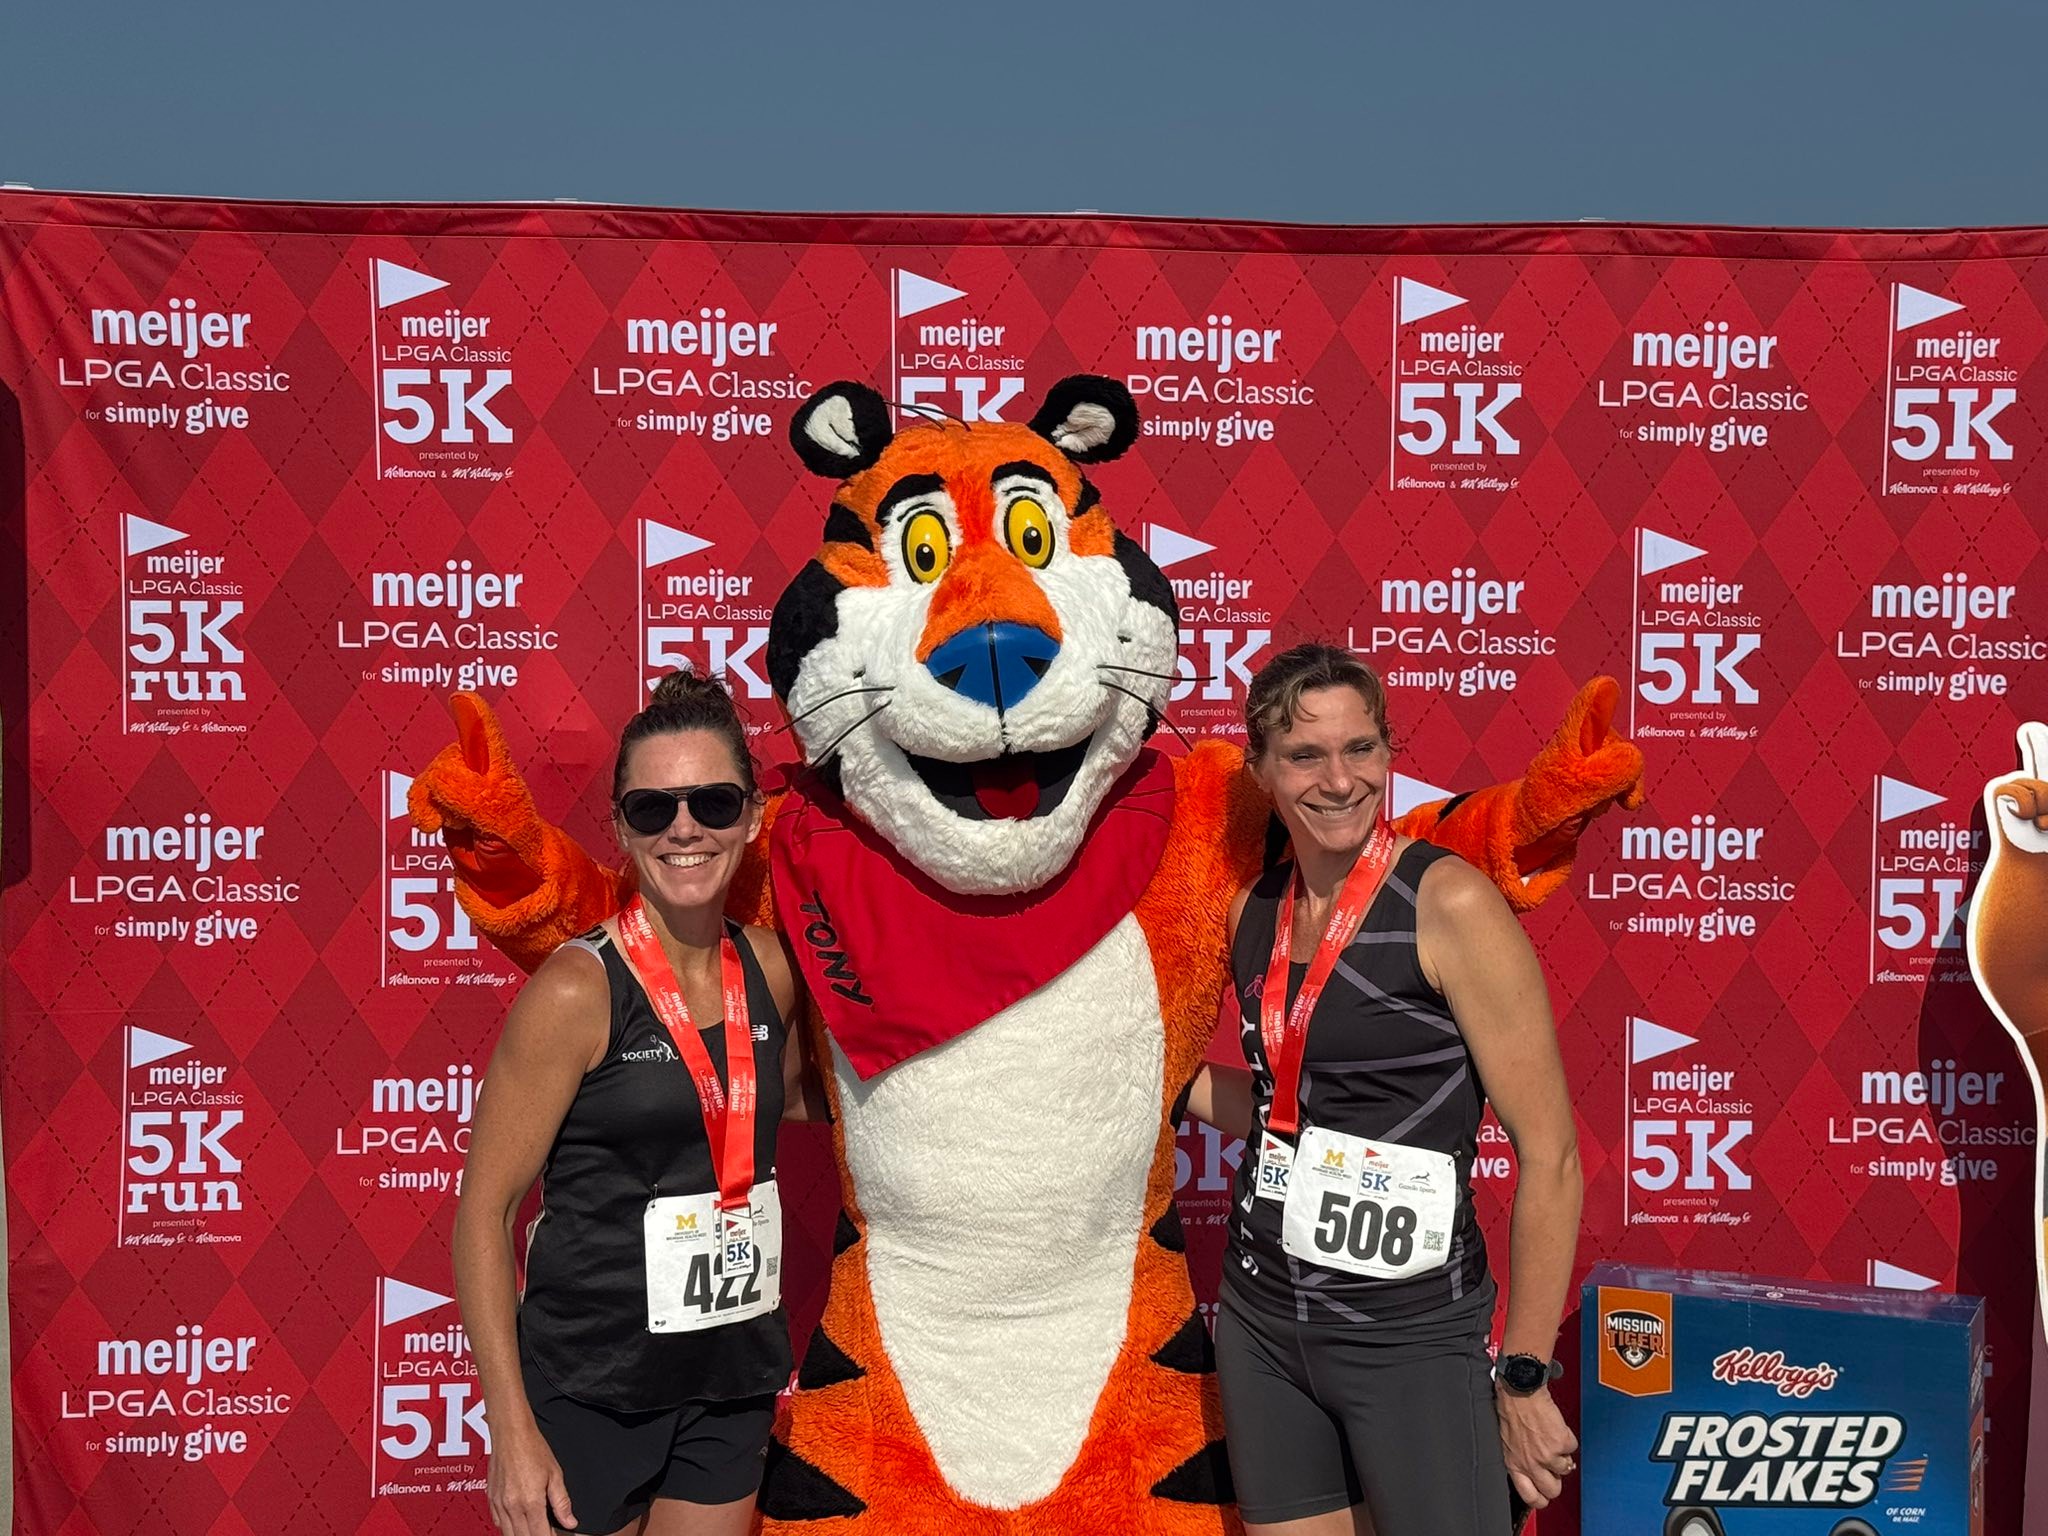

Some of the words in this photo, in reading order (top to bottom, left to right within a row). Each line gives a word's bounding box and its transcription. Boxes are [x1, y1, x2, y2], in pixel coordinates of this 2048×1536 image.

[91, 298, 251, 358] meijer
[402, 309, 490, 344] meijer
[627, 307, 777, 367] meijer
[920, 318, 1005, 352] meijer
[1421, 325, 1504, 359] meijer
[382, 345, 448, 361] LPGA
[450, 346, 511, 362] Classic
[1137, 315, 1281, 373] meijer
[1633, 321, 1777, 379] meijer
[1916, 331, 2000, 364] meijer
[59, 358, 175, 388] LPGA
[181, 363, 290, 391] Classic
[901, 353, 963, 369] LPGA
[966, 354, 1024, 370] Classic
[1401, 360, 1462, 375] LPGA
[1464, 360, 1522, 376] Classic
[1896, 365, 1957, 381] LPGA
[1960, 366, 2017, 382] Classic
[594, 367, 703, 396] LPGA
[709, 371, 812, 399] Classic
[900, 376, 1025, 423] 5K
[1214, 377, 1314, 405] Classic
[1599, 380, 1703, 408] LPGA
[1709, 383, 1808, 411] Classic
[85, 409, 100, 420] for
[105, 401, 180, 428] simply
[185, 397, 249, 434] give
[383, 369, 513, 444] 5K
[617, 417, 632, 427] for
[637, 409, 707, 436] simply
[712, 405, 772, 441] give
[1398, 383, 1522, 455] 5K
[1143, 415, 1211, 441] simply
[1216, 411, 1274, 447] give
[1620, 429, 1634, 439] for
[1638, 421, 1706, 447] simply
[1709, 417, 1768, 452] give
[1891, 388, 2016, 461] 5K
[419, 451, 466, 460] presented
[468, 451, 479, 462] by
[147, 550, 225, 579] meijer
[130, 580, 187, 594] LPGA
[189, 581, 243, 595] Classic
[373, 560, 523, 619] meijer
[667, 568, 753, 602] meijer
[1170, 572, 1252, 605] meijer
[1382, 567, 1524, 625] meijer
[1661, 576, 1743, 610] meijer
[1872, 572, 2015, 629] meijer
[648, 603, 710, 619] LPGA
[713, 604, 772, 620] Classic
[1213, 607, 1271, 623] Classic
[1641, 610, 1701, 626] LPGA
[1704, 611, 1761, 627] Classic
[129, 600, 244, 664] 5K
[338, 621, 449, 648] LPGA
[455, 623, 558, 650] Classic
[1348, 627, 1452, 653] LPGA
[1457, 629, 1556, 655] Classic
[1838, 631, 1942, 658] LPGA
[1948, 633, 2047, 660] Classic
[362, 670, 377, 680] for
[382, 662, 453, 687] simply
[457, 657, 518, 691] give
[647, 627, 772, 698] 5K
[1387, 666, 1455, 691] simply
[1459, 661, 1517, 697] give
[1638, 633, 1761, 704] 5K
[131, 671, 246, 701] run
[1858, 679, 1873, 689] for
[1877, 671, 1945, 696] simply
[1948, 666, 2007, 701] give
[107, 813, 264, 872] meijer
[1622, 815, 1763, 871] meijer
[1900, 823, 1983, 855] meijer
[391, 855, 454, 870] LPGA
[1881, 856, 1941, 872] LPGA
[70, 875, 187, 903] LPGA
[192, 876, 300, 902] Classic
[1589, 873, 1692, 899] LPGA
[1697, 875, 1795, 901] Classic
[94, 925, 110, 935] for
[115, 916, 190, 941] simply
[194, 910, 257, 946] give
[1609, 920, 1624, 930] for
[1627, 912, 1694, 937] simply
[1698, 907, 1756, 942] give
[799, 889, 873, 1007] TONY
[622, 1050, 661, 1061] SOCIETY
[150, 1060, 227, 1090] meijer
[1653, 1064, 1734, 1097] meijer
[1861, 1060, 2004, 1116] meijer
[131, 1091, 188, 1106] LPGA
[190, 1091, 244, 1105] Classic
[1633, 1098, 1693, 1113] LPGA
[1696, 1098, 1753, 1114] Classic
[128, 1110, 243, 1176] 5K
[337, 1127, 448, 1154] LPGA
[1829, 1117, 1933, 1143] LPGA
[1937, 1120, 2036, 1146] Classic
[1323, 1149, 1346, 1168] M
[1631, 1120, 1753, 1191] 5K
[1850, 1164, 1864, 1174] for
[1868, 1156, 1936, 1181] simply
[1940, 1152, 1998, 1187] give
[359, 1176, 374, 1187] for
[379, 1167, 451, 1192] simply
[1263, 1166, 1289, 1187] 5K
[1361, 1172, 1392, 1192] 5K
[127, 1181, 242, 1213] run
[676, 1213, 698, 1230] M
[1314, 1190, 1417, 1266] 508
[727, 1241, 750, 1262] 5K
[684, 1244, 762, 1314] 422
[1606, 1315, 1662, 1335] MISSION
[1608, 1331, 1664, 1352] TIGER
[98, 1325, 256, 1385] meijer
[384, 1360, 448, 1378] LPGA
[1712, 1346, 1838, 1398] Kellogg's
[62, 1389, 176, 1418] LPGA
[182, 1387, 291, 1416] Classic
[85, 1440, 101, 1451] for
[106, 1431, 179, 1457] simply
[183, 1423, 247, 1461] give
[1657, 1416, 1903, 1457] FROSTED
[1672, 1461, 1881, 1503] FLAKES
[1886, 1508, 1899, 1516] OF
[1900, 1508, 1926, 1516] CORN
